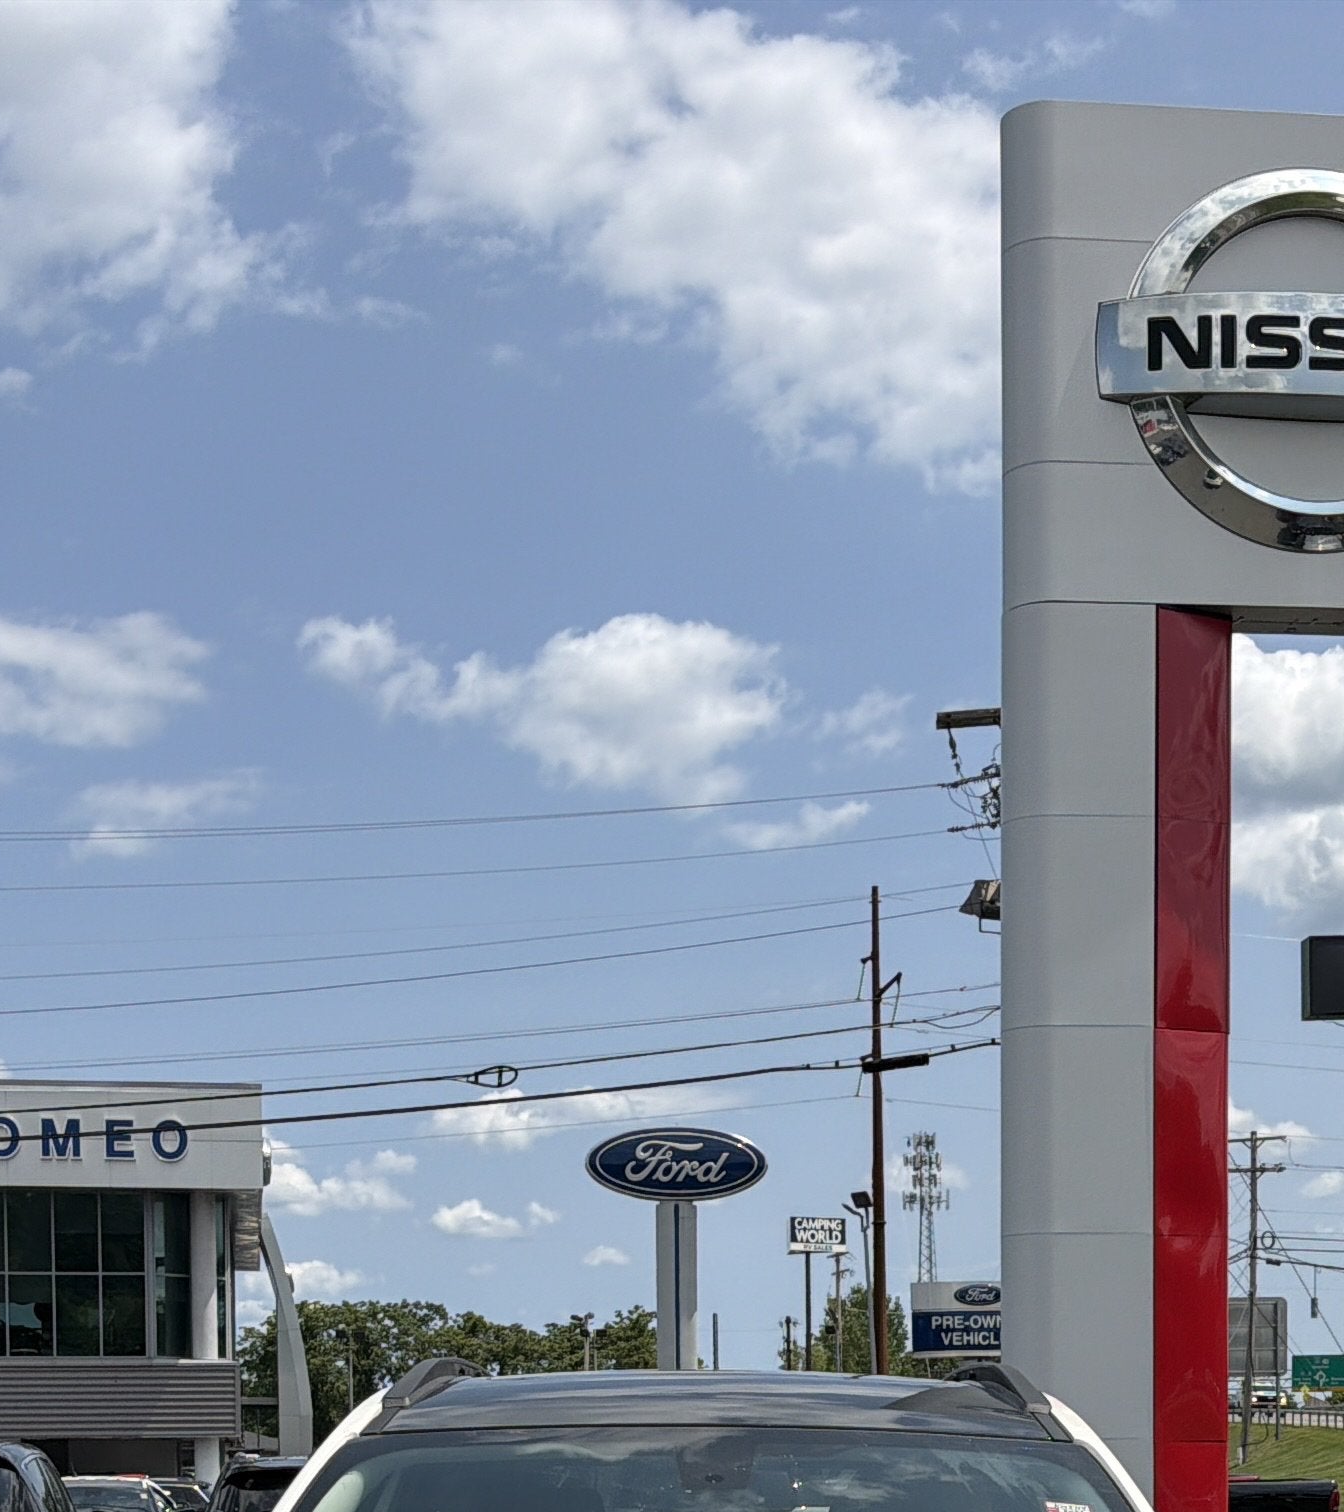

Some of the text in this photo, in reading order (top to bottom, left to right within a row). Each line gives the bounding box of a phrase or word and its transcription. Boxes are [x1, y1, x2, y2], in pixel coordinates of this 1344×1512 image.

[624, 1140, 730, 1183] Ford
[794, 1217, 842, 1231] CAMPING
[794, 1229, 842, 1244] WORLD
[964, 1287, 997, 1302] Ford
[940, 1331, 1000, 1346] VEHICL
